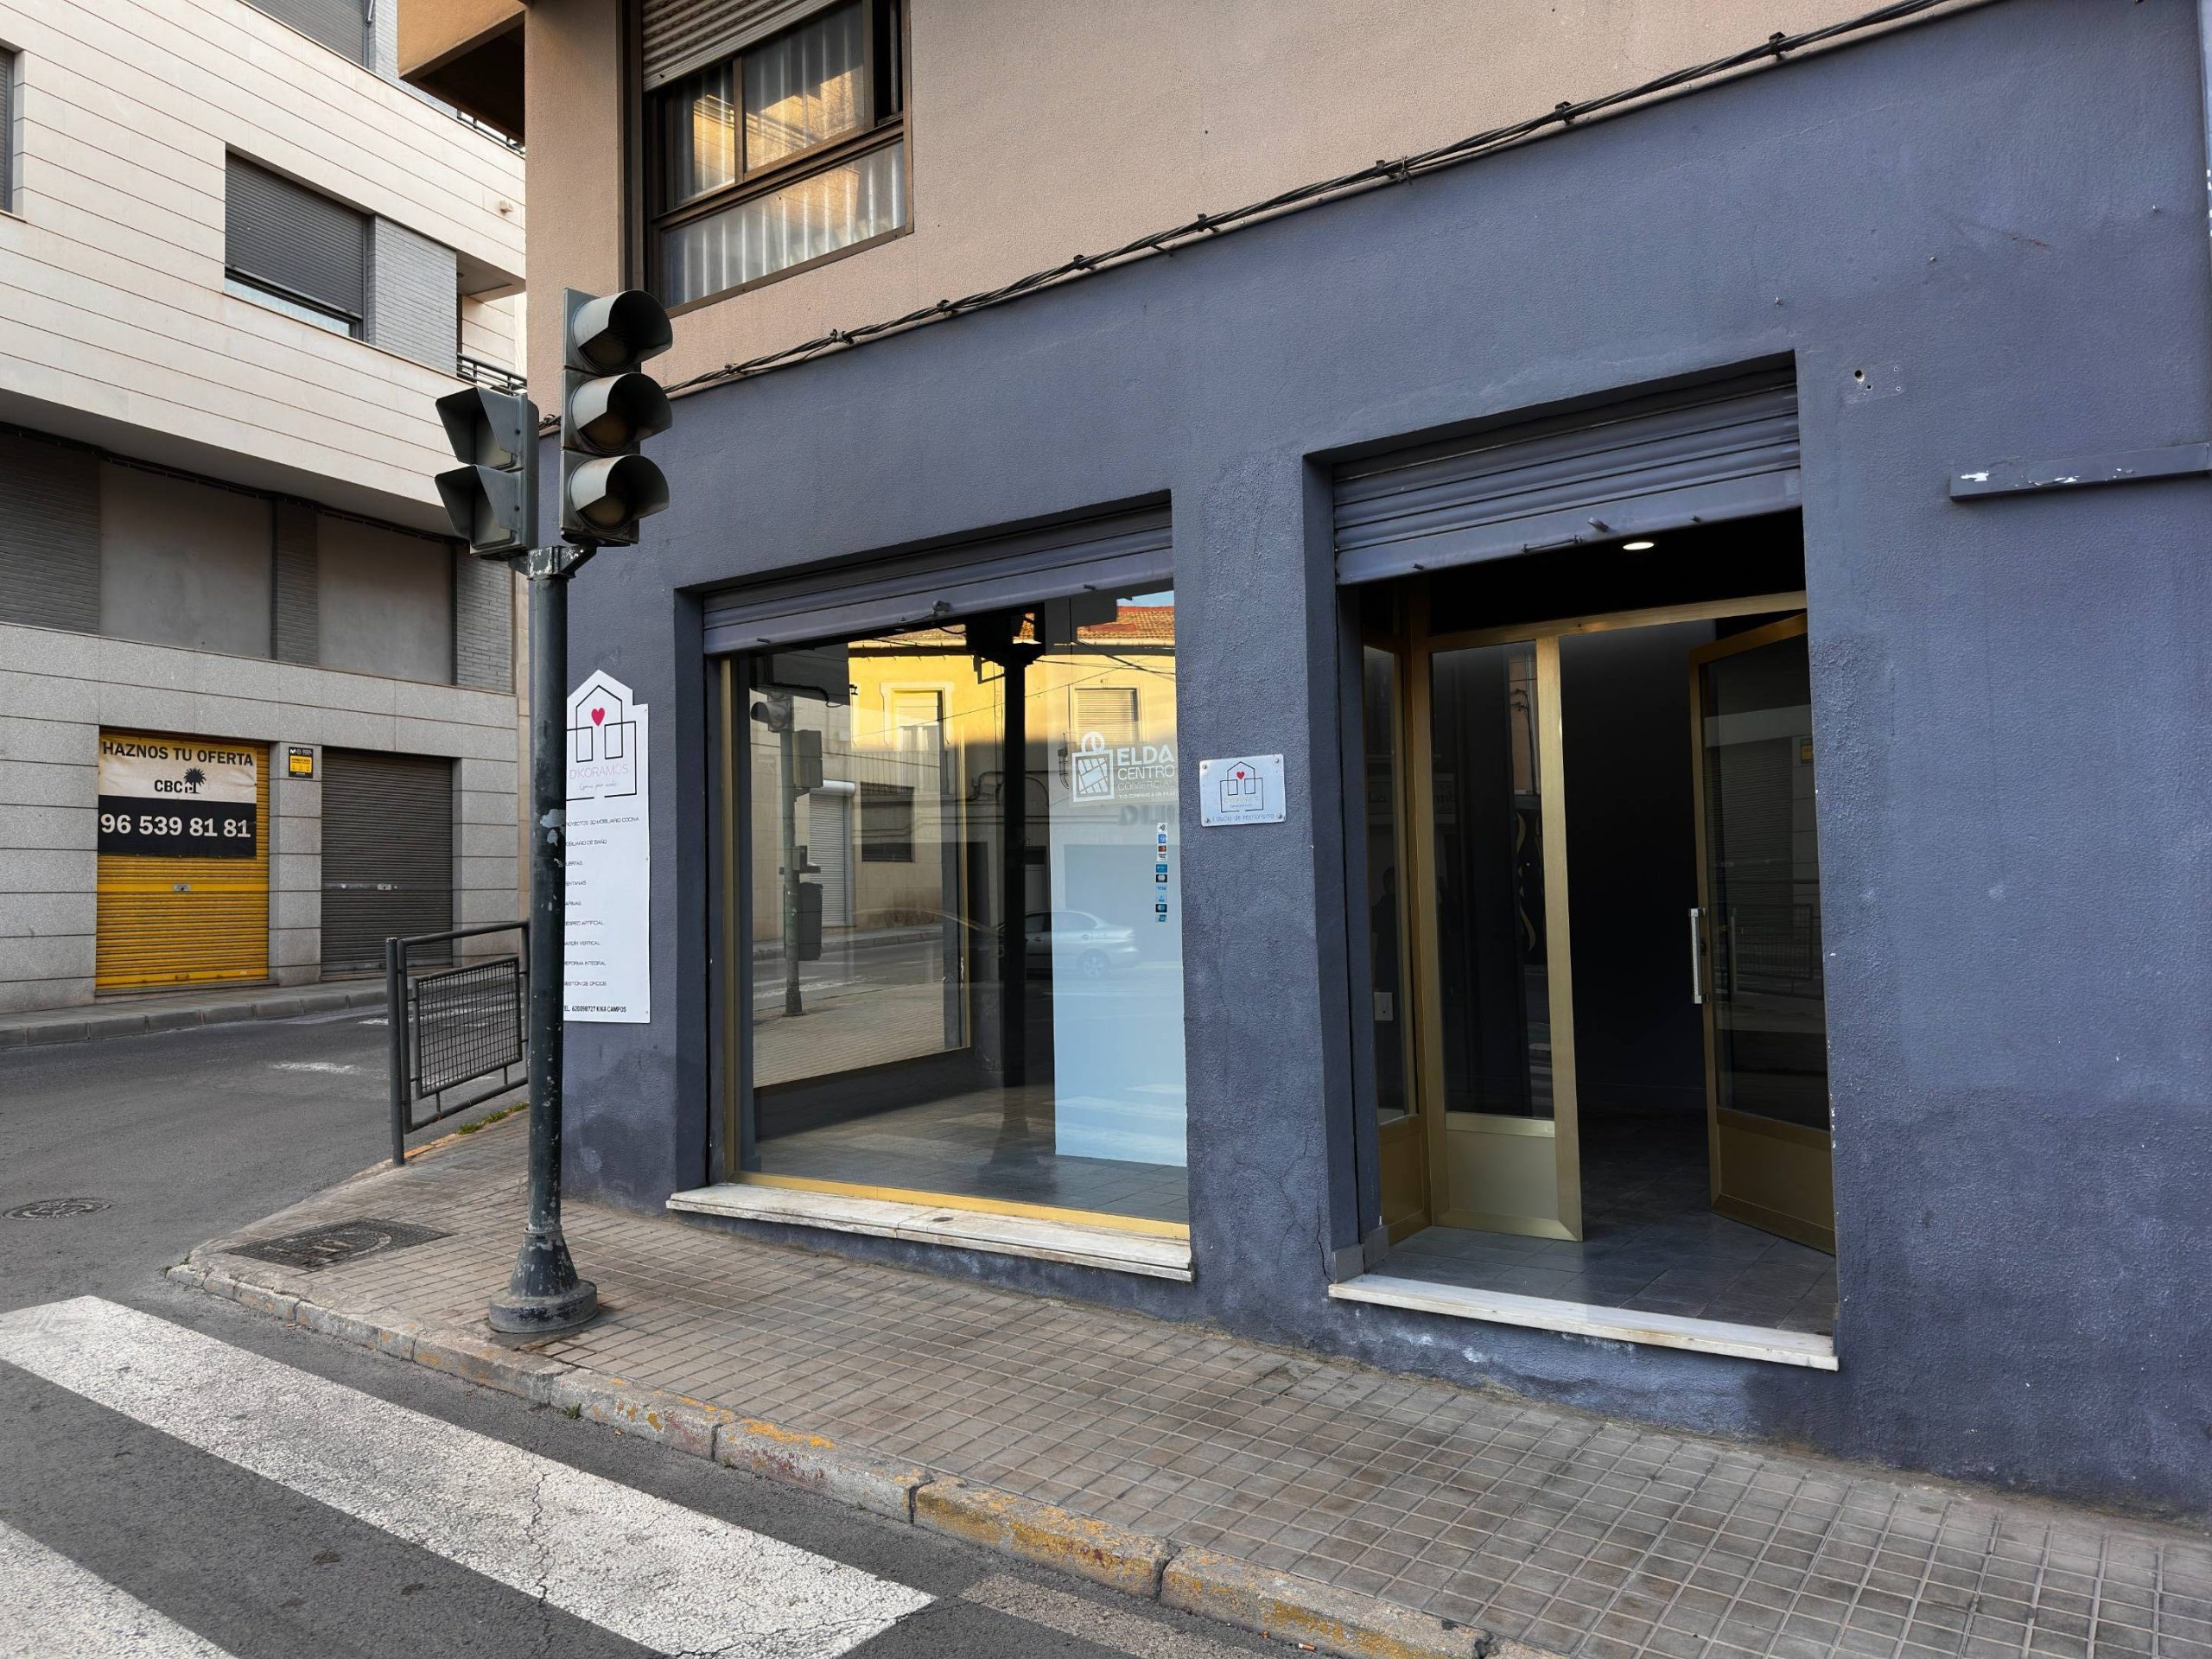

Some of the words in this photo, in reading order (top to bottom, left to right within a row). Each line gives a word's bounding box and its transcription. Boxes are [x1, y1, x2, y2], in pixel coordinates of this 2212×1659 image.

[103, 741, 168, 760] HAZNOS
[173, 747, 192, 761] TU
[197, 749, 253, 766] OFERTA
[1117, 744, 1175, 766] ELDA
[1117, 765, 1175, 780] CENTRO
[154, 779, 183, 793] CBC
[100, 813, 131, 834] 96
[138, 816, 182, 836] 539
[189, 817, 218, 837] 81
[223, 819, 251, 837] 81
